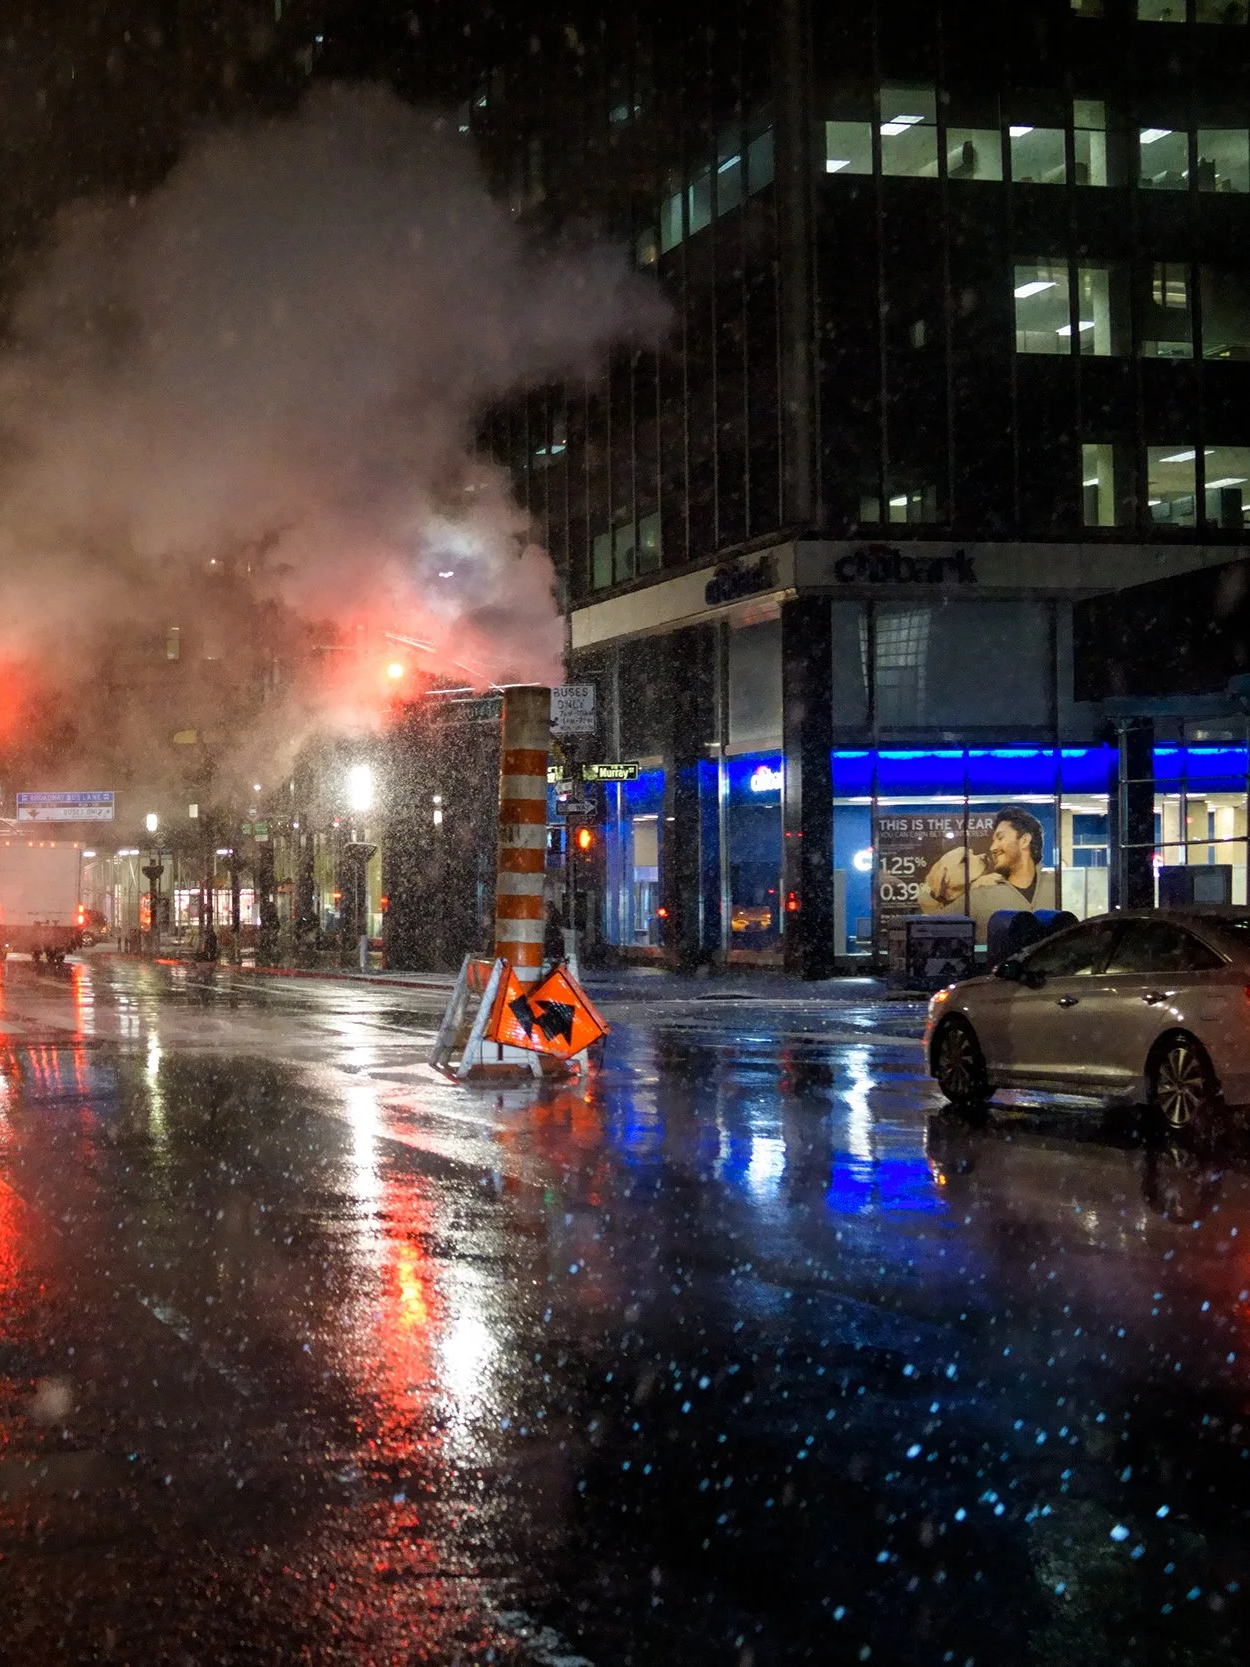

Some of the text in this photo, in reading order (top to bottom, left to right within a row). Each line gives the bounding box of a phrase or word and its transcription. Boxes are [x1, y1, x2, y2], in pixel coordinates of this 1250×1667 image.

[553, 687, 589, 698] BUSES
[599, 767, 629, 780] Murray
[878, 819, 908, 831] THIS
[911, 819, 924, 831] IS
[927, 819, 951, 830] THE
[879, 831, 894, 839] YOU
[880, 856, 927, 875] 1.25%
[880, 883, 931, 901] 0.39%
